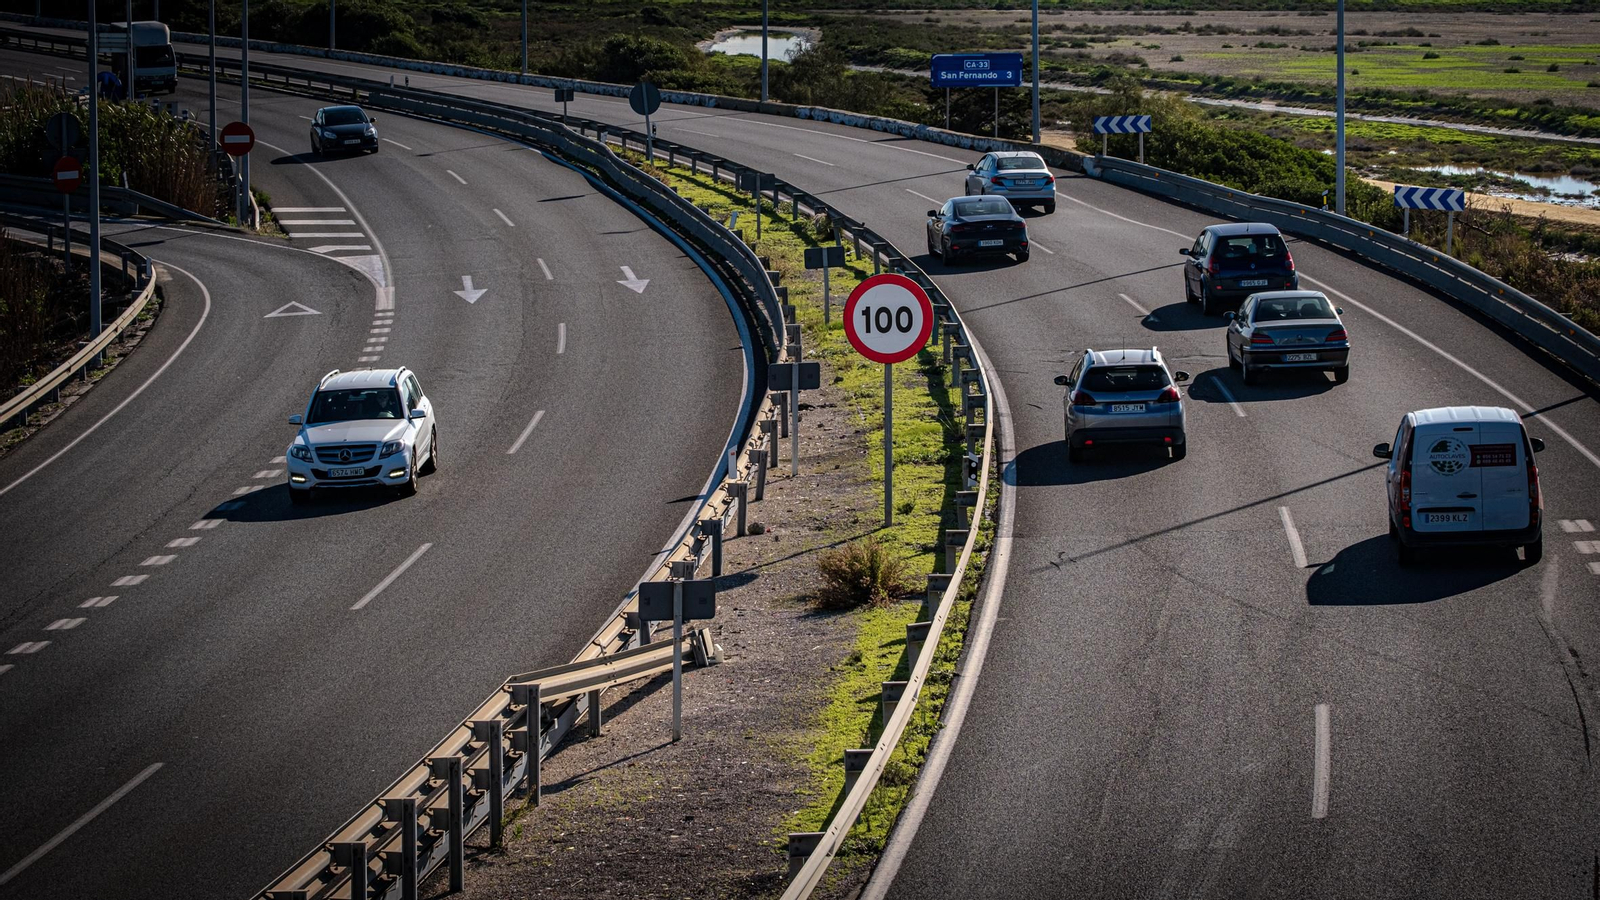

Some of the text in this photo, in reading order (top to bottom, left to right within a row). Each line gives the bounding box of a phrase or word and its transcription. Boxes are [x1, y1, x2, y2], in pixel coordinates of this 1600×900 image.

[941, 70, 1012, 79] San Fernando 3
[861, 306, 913, 334] 100
[1430, 514, 1468, 522] 2399 KLZ
